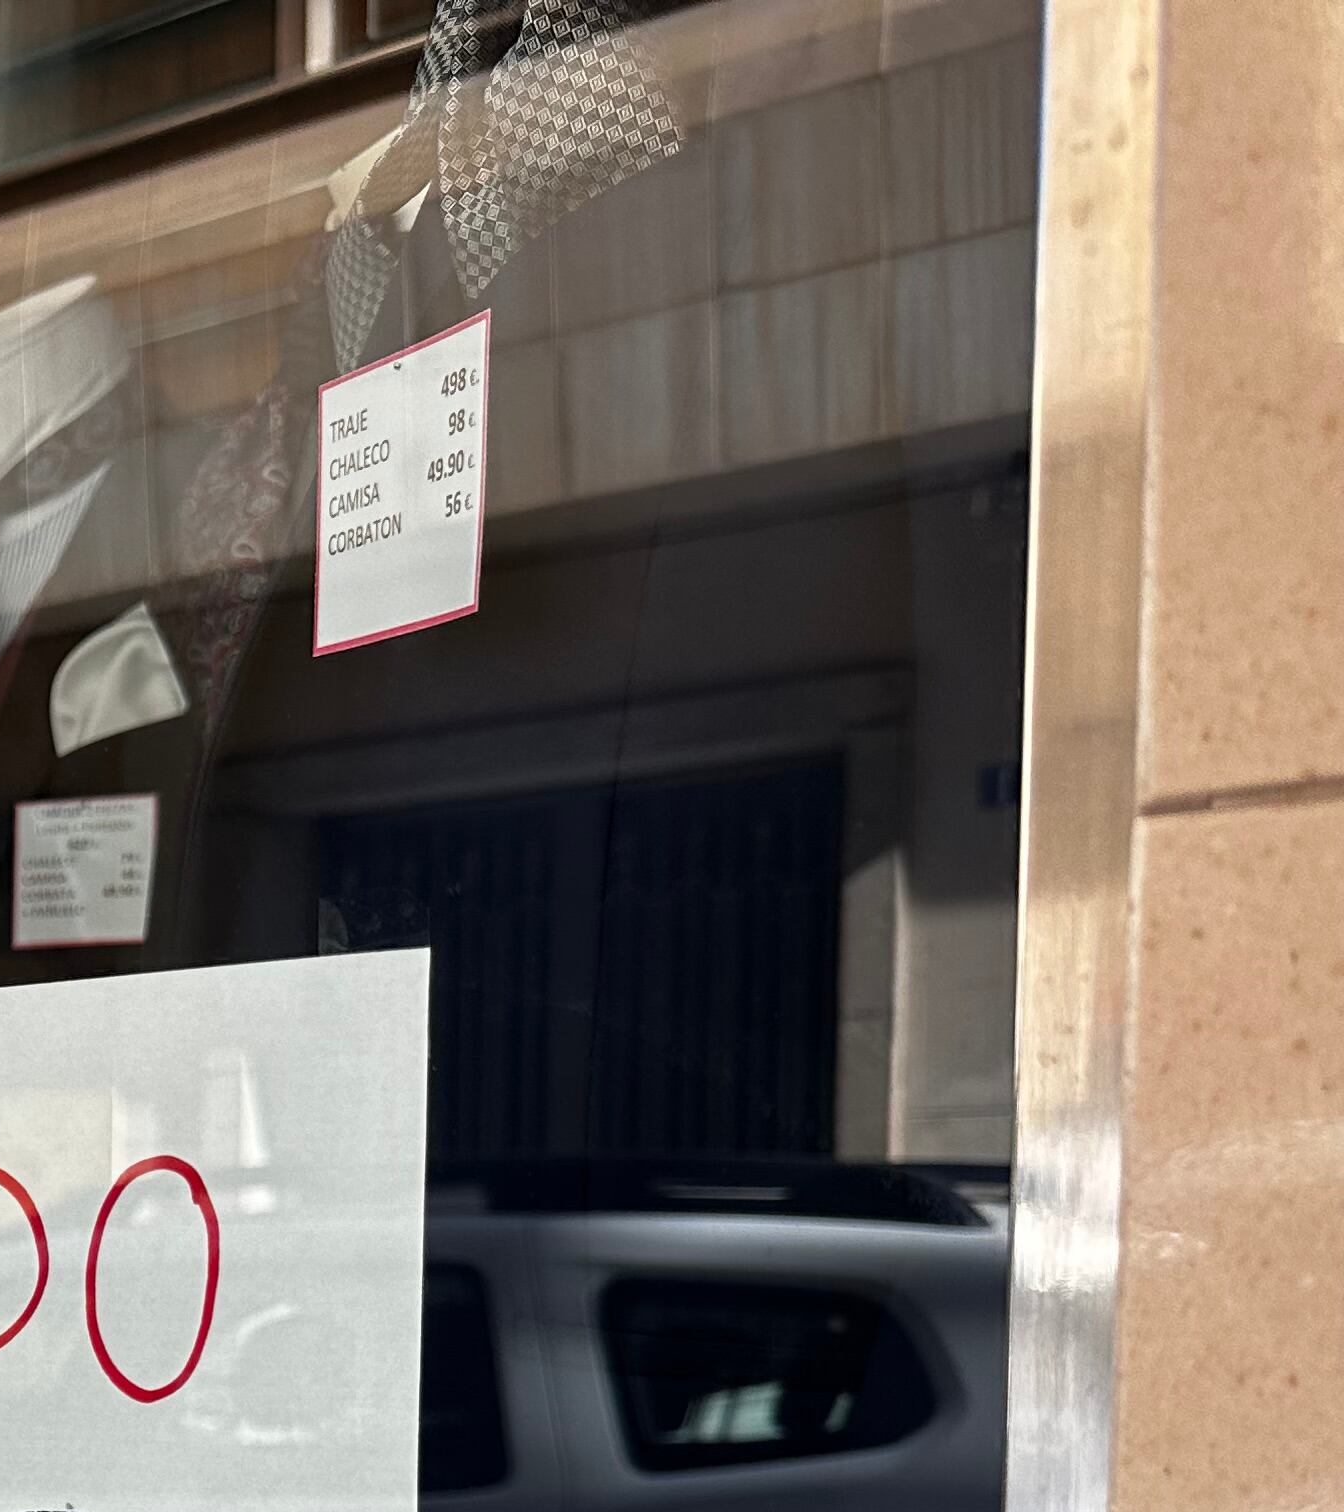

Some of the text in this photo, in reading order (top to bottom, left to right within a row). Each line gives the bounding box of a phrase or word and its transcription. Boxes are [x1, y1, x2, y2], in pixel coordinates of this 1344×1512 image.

[329, 407, 369, 444] TRAJE
[440, 367, 468, 399] 498
[329, 438, 391, 481] CHALECO
[448, 407, 467, 437] 98
[328, 482, 382, 520] CAMISA
[426, 449, 465, 483] 49.90
[327, 511, 403, 557] CORBATON
[444, 490, 463, 518] 56
